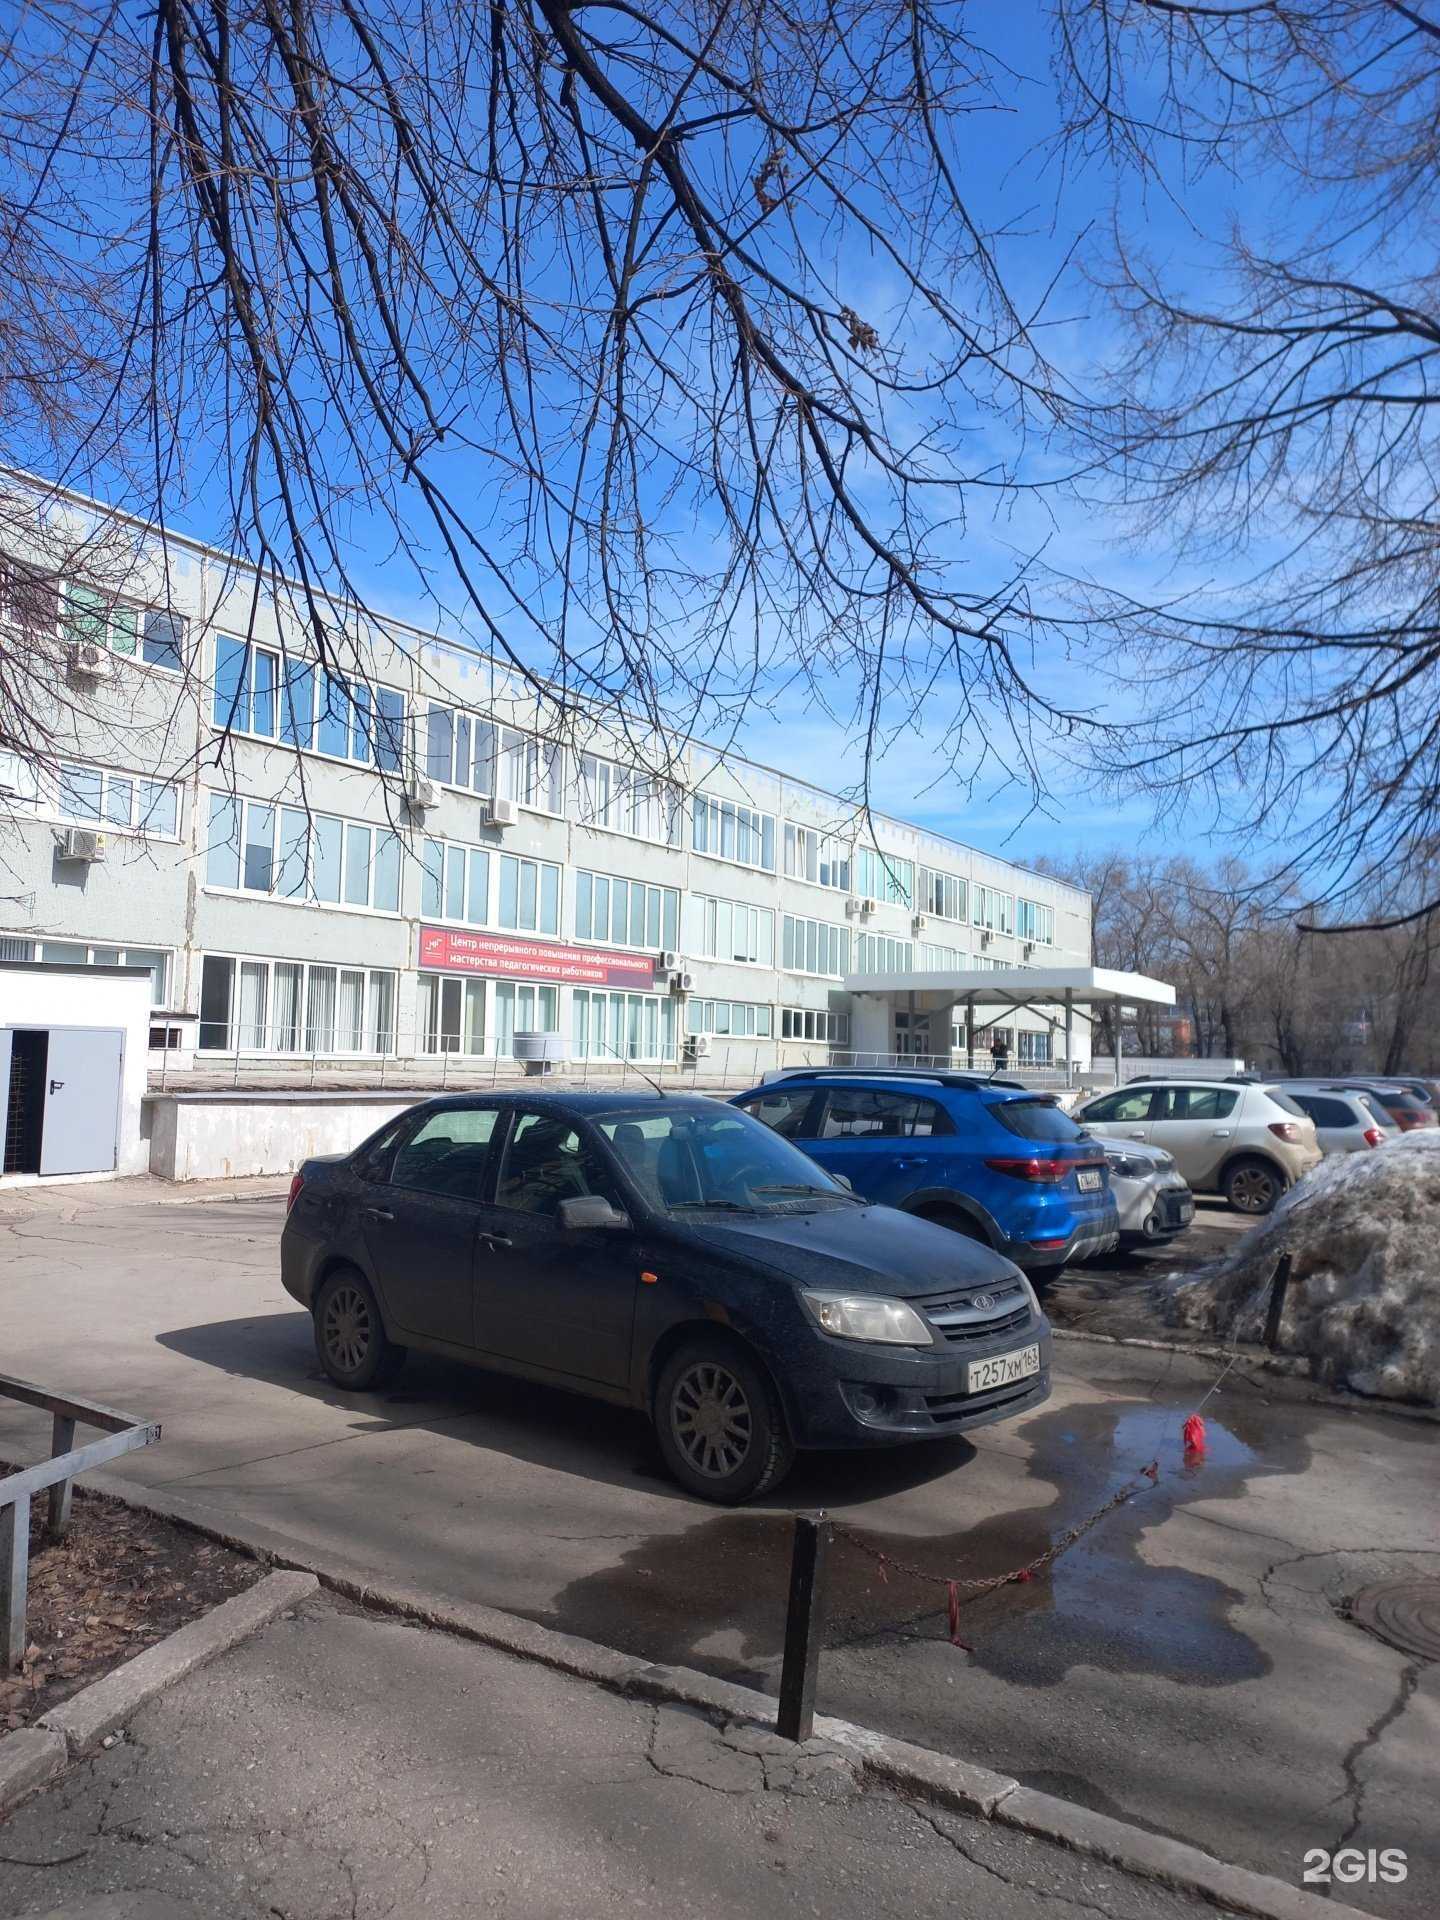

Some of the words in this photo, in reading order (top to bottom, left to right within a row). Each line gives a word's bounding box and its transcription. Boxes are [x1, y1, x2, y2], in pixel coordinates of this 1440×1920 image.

[450, 934, 477, 951] Центр
[479, 940, 537, 955] непрерывного
[539, 949, 580, 962] повышения
[582, 953, 649, 970] профессионального
[450, 953, 498, 968] мастерства
[500, 959, 560, 975] педагогических
[562, 966, 603, 979] работников
